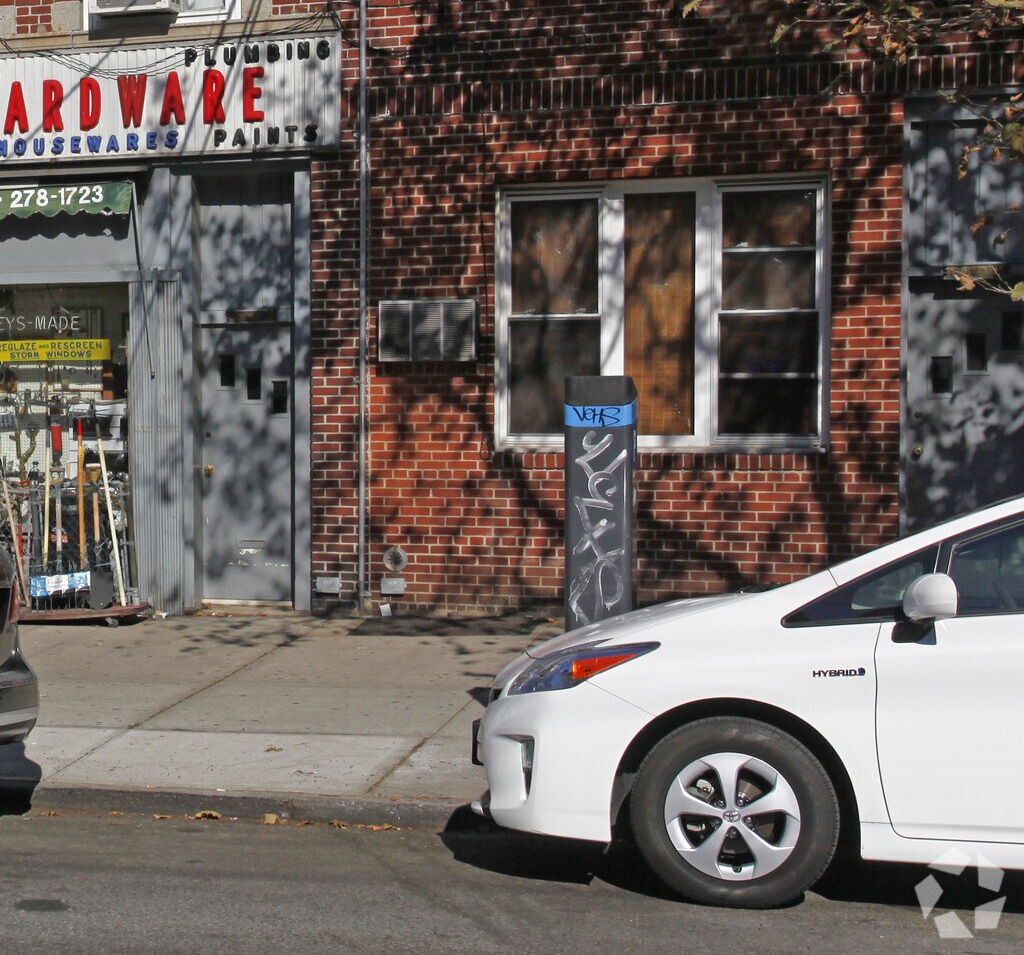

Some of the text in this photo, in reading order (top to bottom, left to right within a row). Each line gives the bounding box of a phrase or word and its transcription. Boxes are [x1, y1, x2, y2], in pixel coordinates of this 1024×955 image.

[184, 39, 331, 67] PLUMBING
[214, 123, 318, 148] PAINTS
[9, 185, 104, 209] 278-1723
[46, 350, 92, 358] WINDOWS
[50, 341, 103, 351] RESCREEN
[812, 669, 857, 678] HYBRID
